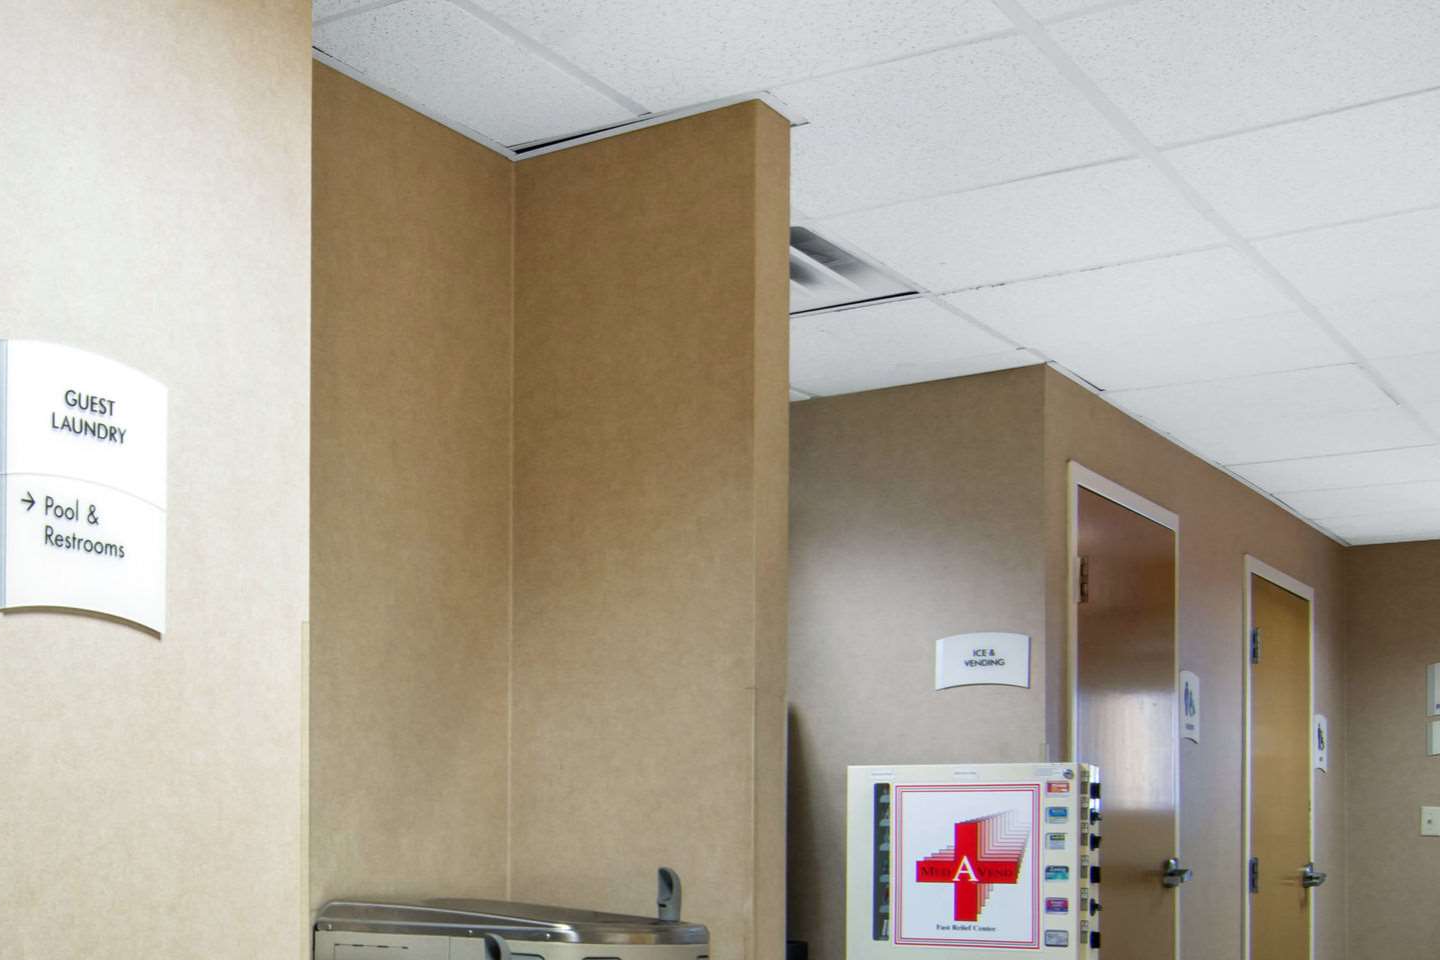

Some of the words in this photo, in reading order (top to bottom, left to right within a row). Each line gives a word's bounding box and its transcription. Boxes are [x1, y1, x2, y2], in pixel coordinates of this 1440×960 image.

[64, 389, 115, 416] GUEST
[52, 412, 127, 444] LAUNDRY
[45, 496, 79, 521] Pool
[87, 504, 99, 525] &
[45, 525, 125, 558] Restrooms
[964, 658, 1005, 667] VENDING
[972, 649, 987, 657] ICE
[952, 855, 979, 881] A
